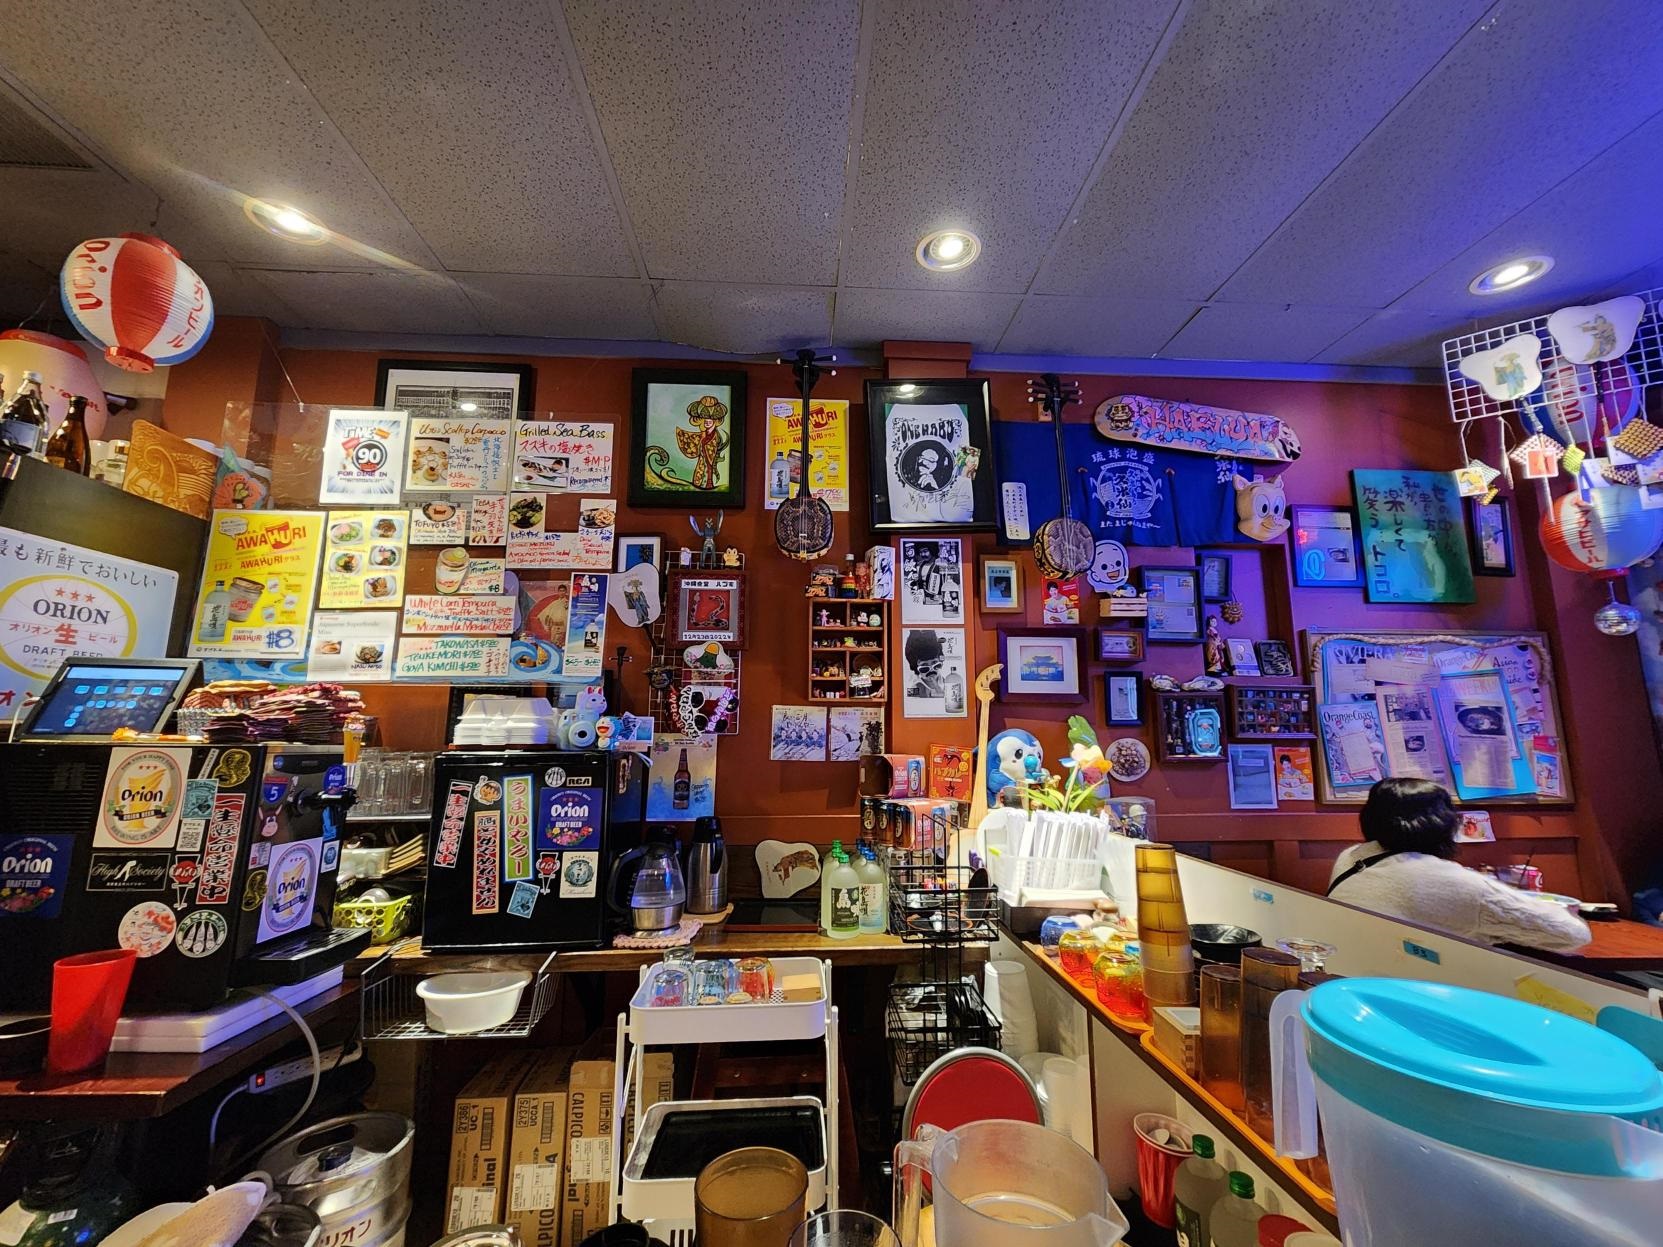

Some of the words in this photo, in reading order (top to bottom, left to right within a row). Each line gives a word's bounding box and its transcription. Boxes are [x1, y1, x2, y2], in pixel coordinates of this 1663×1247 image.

[519, 423, 551, 438] Grilled
[553, 423, 575, 437] Sea
[579, 424, 606, 439] Bass
[901, 421, 921, 443] ONE
[358, 448, 381, 464] 90
[414, 520, 440, 529] TOFUYO
[240, 555, 283, 570] AWAHURI
[33, 598, 111, 625] ORION
[54, 623, 78, 646] 生
[22, 644, 67, 657] DRAFT
[435, 640, 480, 650] TAKOWASA
[426, 662, 459, 673] KIMCHI
[121, 786, 163, 802] Orion
[269, 786, 279, 801] 5
[551, 802, 589, 818] Orion
[2, 854, 53, 873] Orion
[277, 876, 306, 895] Orion
[517, 1098, 529, 1127] 2Y375
[570, 1092, 585, 1138] CALPICO
[321, 1218, 373, 1247] リオン
